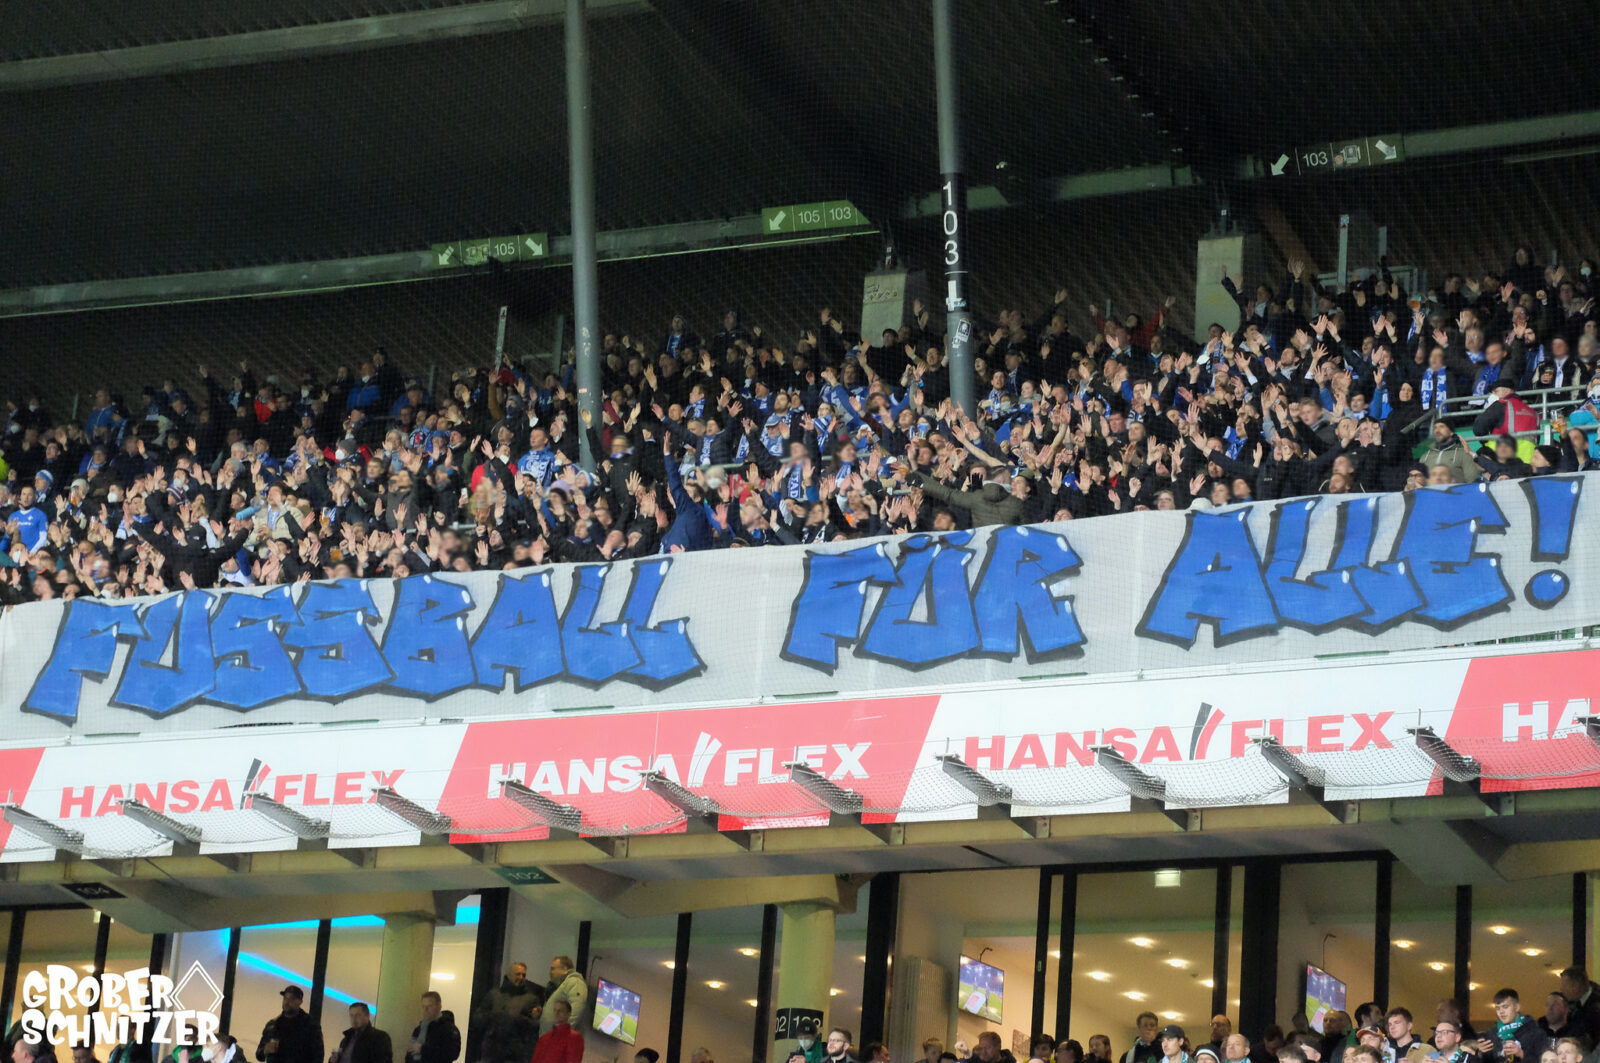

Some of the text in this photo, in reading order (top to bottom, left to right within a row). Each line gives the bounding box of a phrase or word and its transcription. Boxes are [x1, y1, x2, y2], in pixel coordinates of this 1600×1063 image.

[1303, 151, 1328, 167] 103
[798, 206, 852, 224] 105 103
[943, 180, 959, 265] 103
[494, 242, 515, 256] 105
[20, 475, 1585, 726] FUSSBALL FÜR ALLE!
[724, 742, 872, 786] FLEX
[964, 711, 1395, 771] HANSA FLEX
[59, 769, 406, 818] HANSA FLEX
